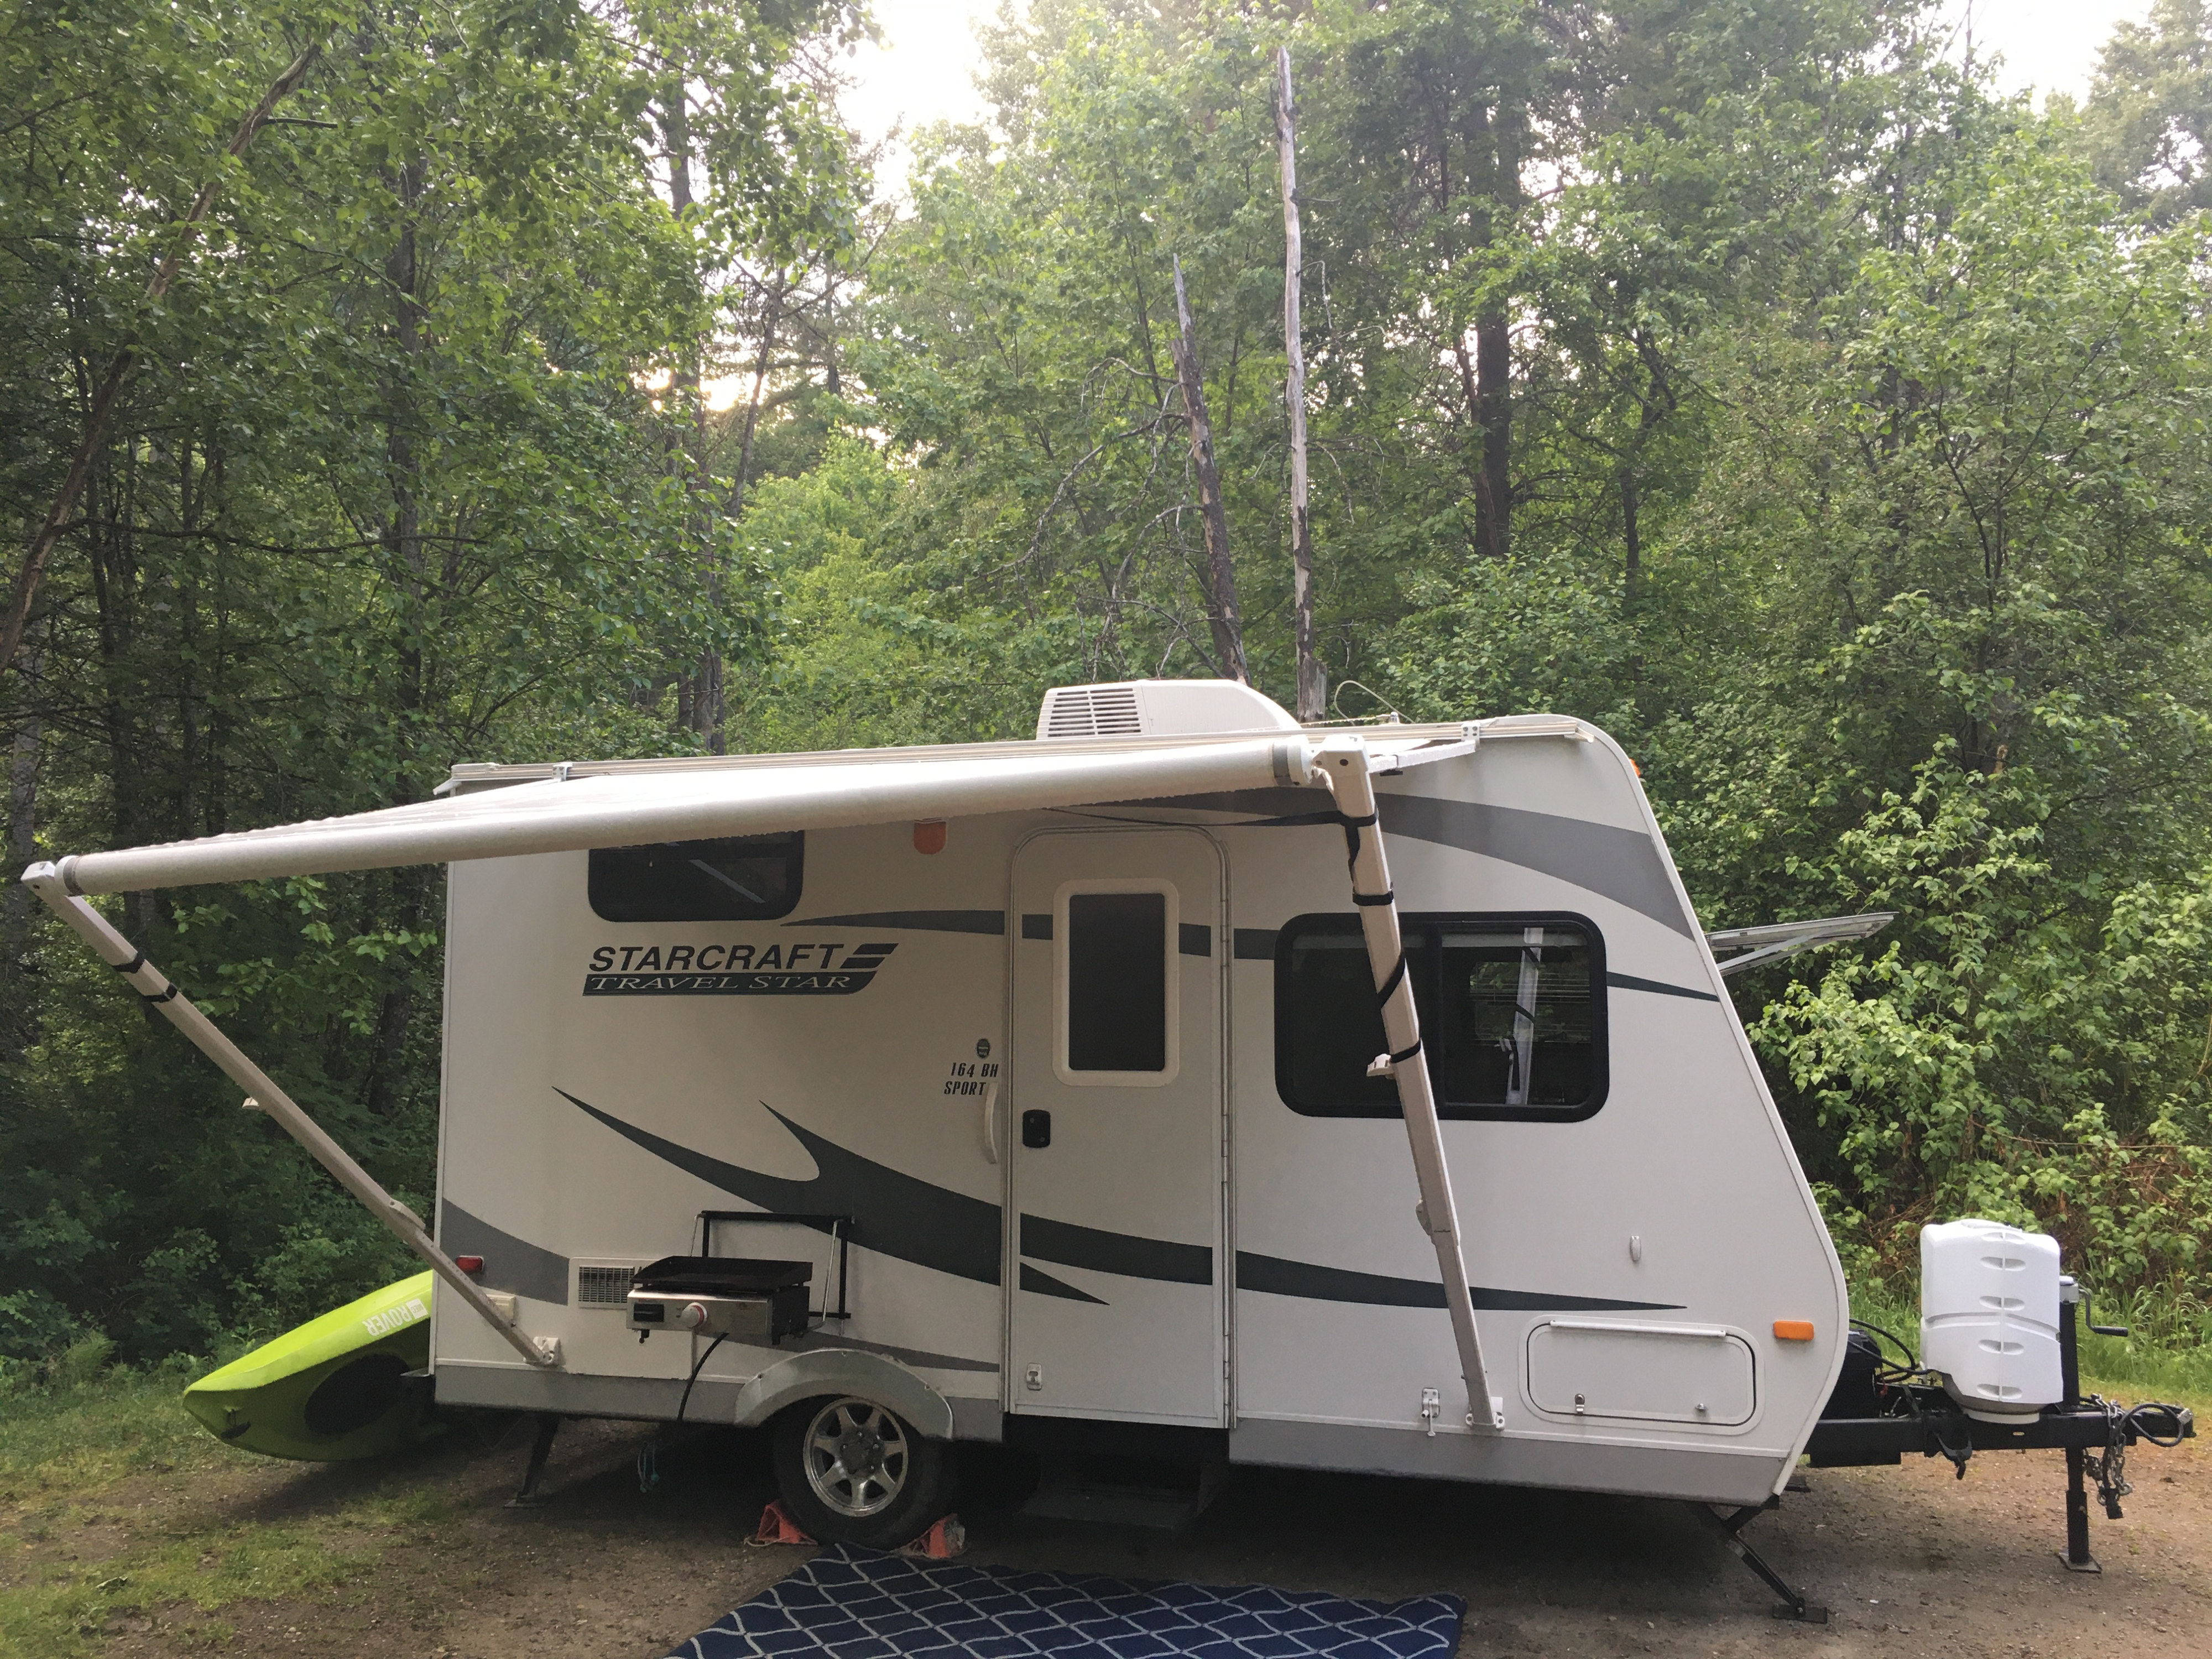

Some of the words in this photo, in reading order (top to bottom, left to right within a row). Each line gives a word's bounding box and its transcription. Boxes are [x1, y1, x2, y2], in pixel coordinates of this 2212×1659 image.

[589, 944, 844, 972] STARCRAFT
[591, 977, 738, 990] TRAVEL
[749, 975, 851, 989] STAR
[951, 1062, 975, 1078] 164
[981, 1063, 999, 1077] BH
[944, 1081, 987, 1095] SPORT
[362, 1305, 412, 1336] ROVER
